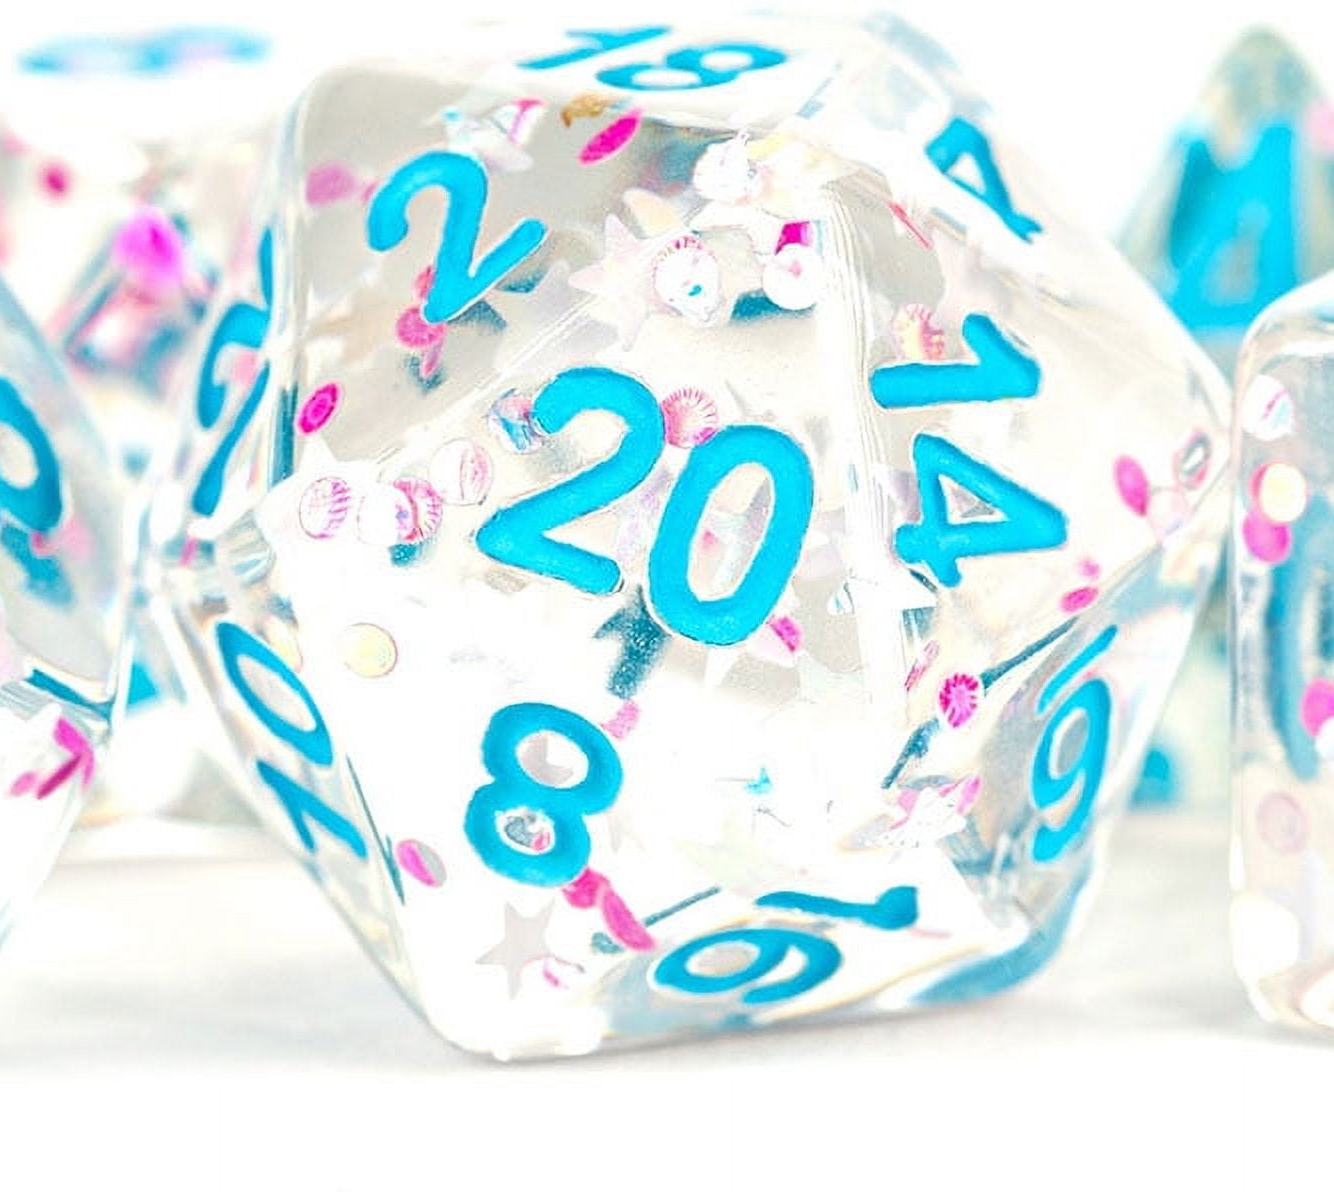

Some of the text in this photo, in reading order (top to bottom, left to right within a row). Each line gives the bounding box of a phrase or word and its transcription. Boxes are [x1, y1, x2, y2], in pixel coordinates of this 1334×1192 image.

[517, 26, 788, 91] 18
[367, 150, 545, 324] 2
[924, 115, 1042, 243] 4
[475, 366, 814, 648] 20
[872, 314, 1068, 589] 14
[464, 702, 624, 887] 8
